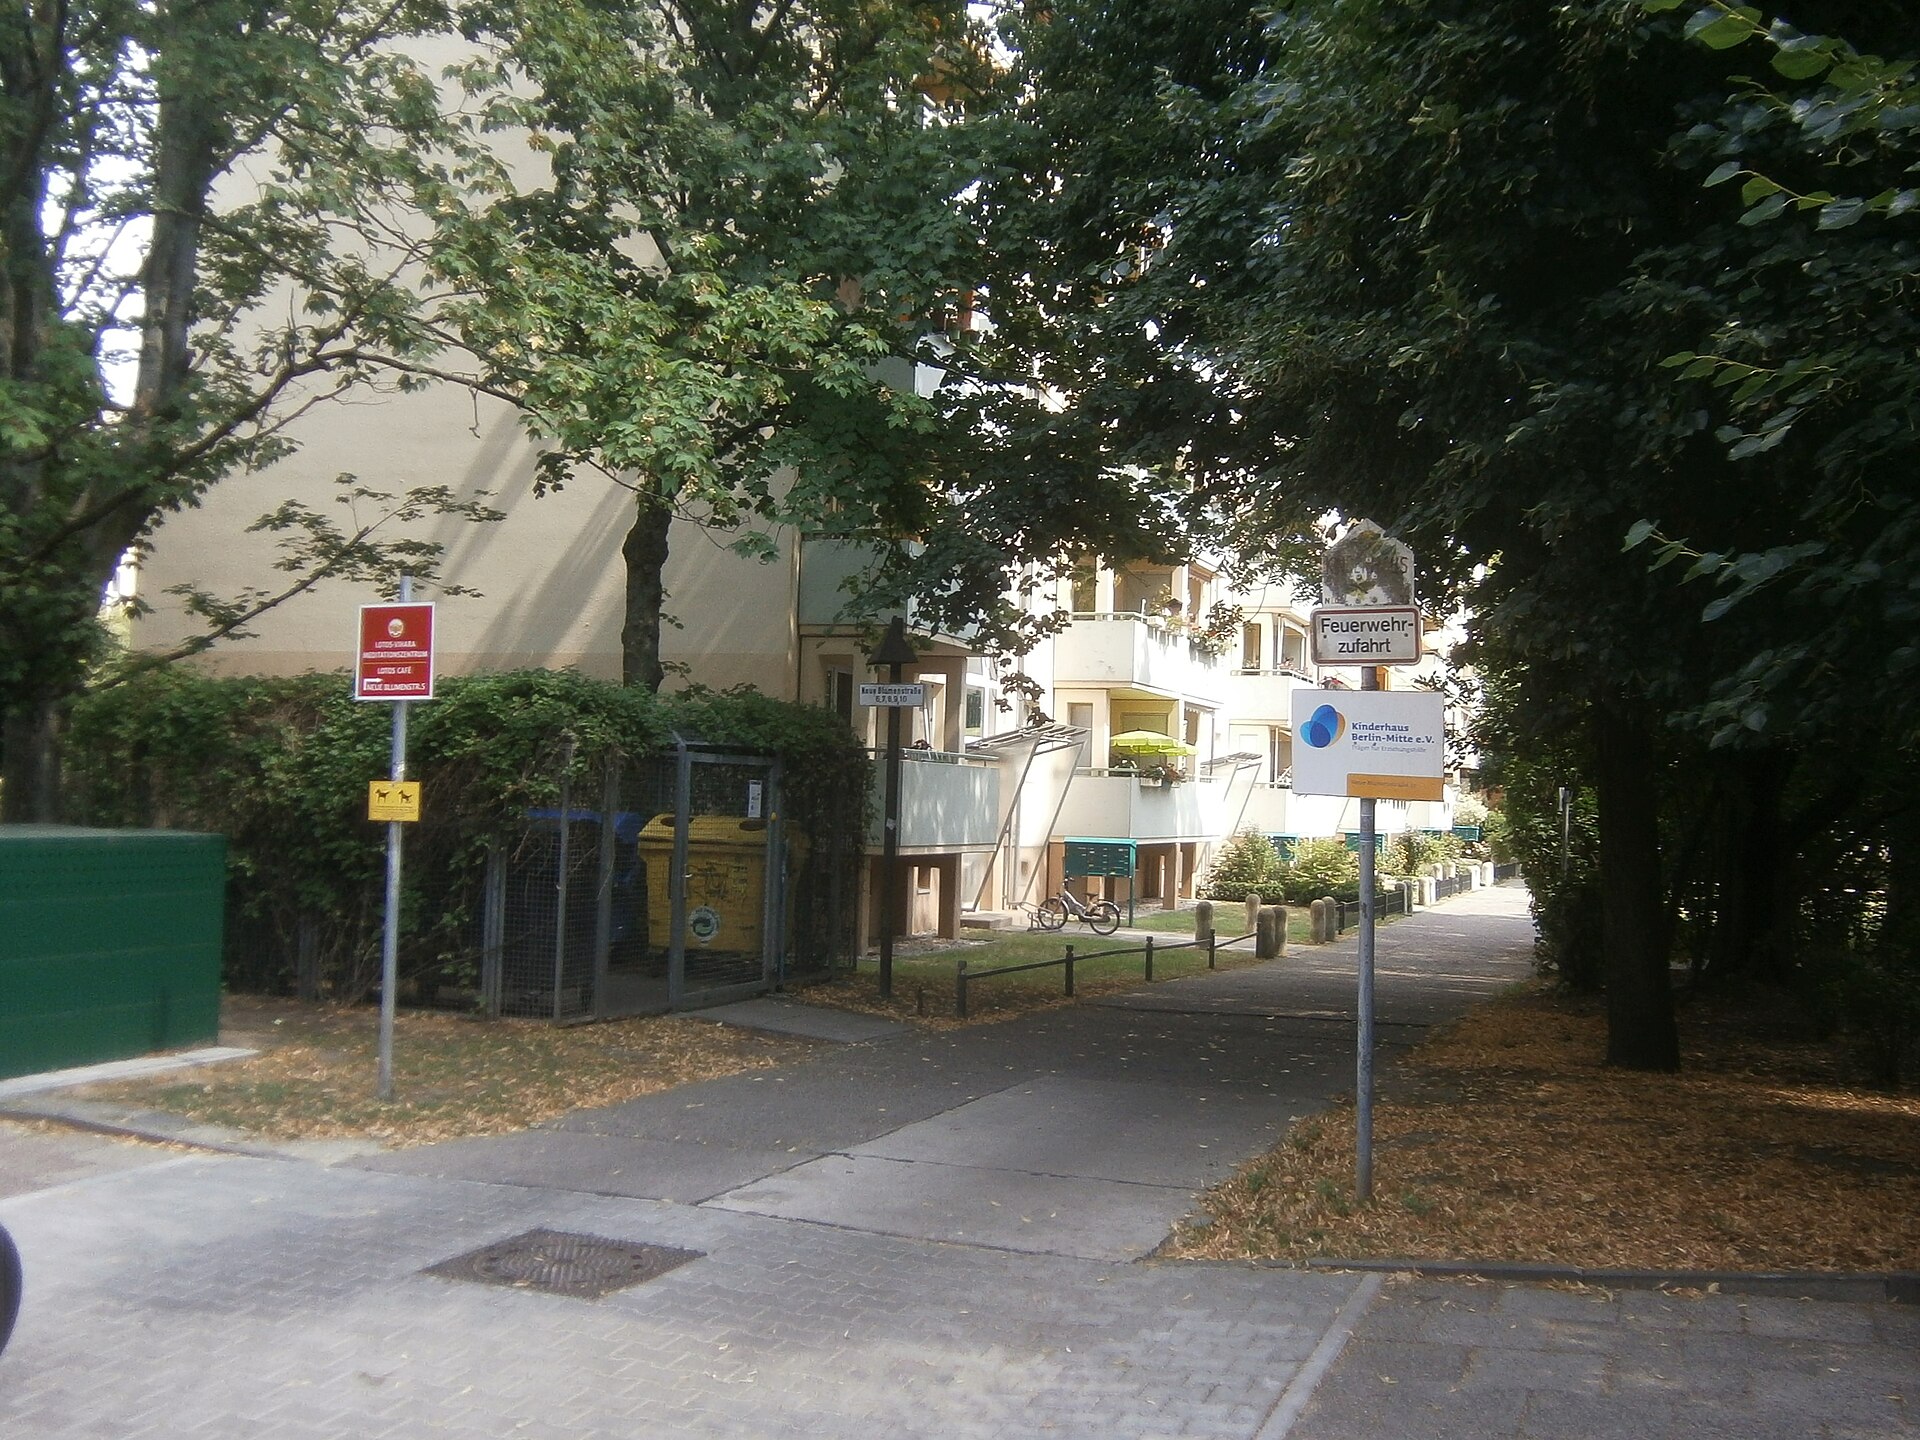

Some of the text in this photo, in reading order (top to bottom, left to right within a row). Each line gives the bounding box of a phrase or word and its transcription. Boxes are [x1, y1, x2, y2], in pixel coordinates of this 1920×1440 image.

[1320, 617, 1414, 633] Feuerwehr-
[1338, 638, 1392, 653] zufahrt
[861, 687, 876, 695] Neue
[1351, 722, 1409, 732] Kinderhaus
[1351, 733, 1435, 744] Berlin-Mitte e.V.
